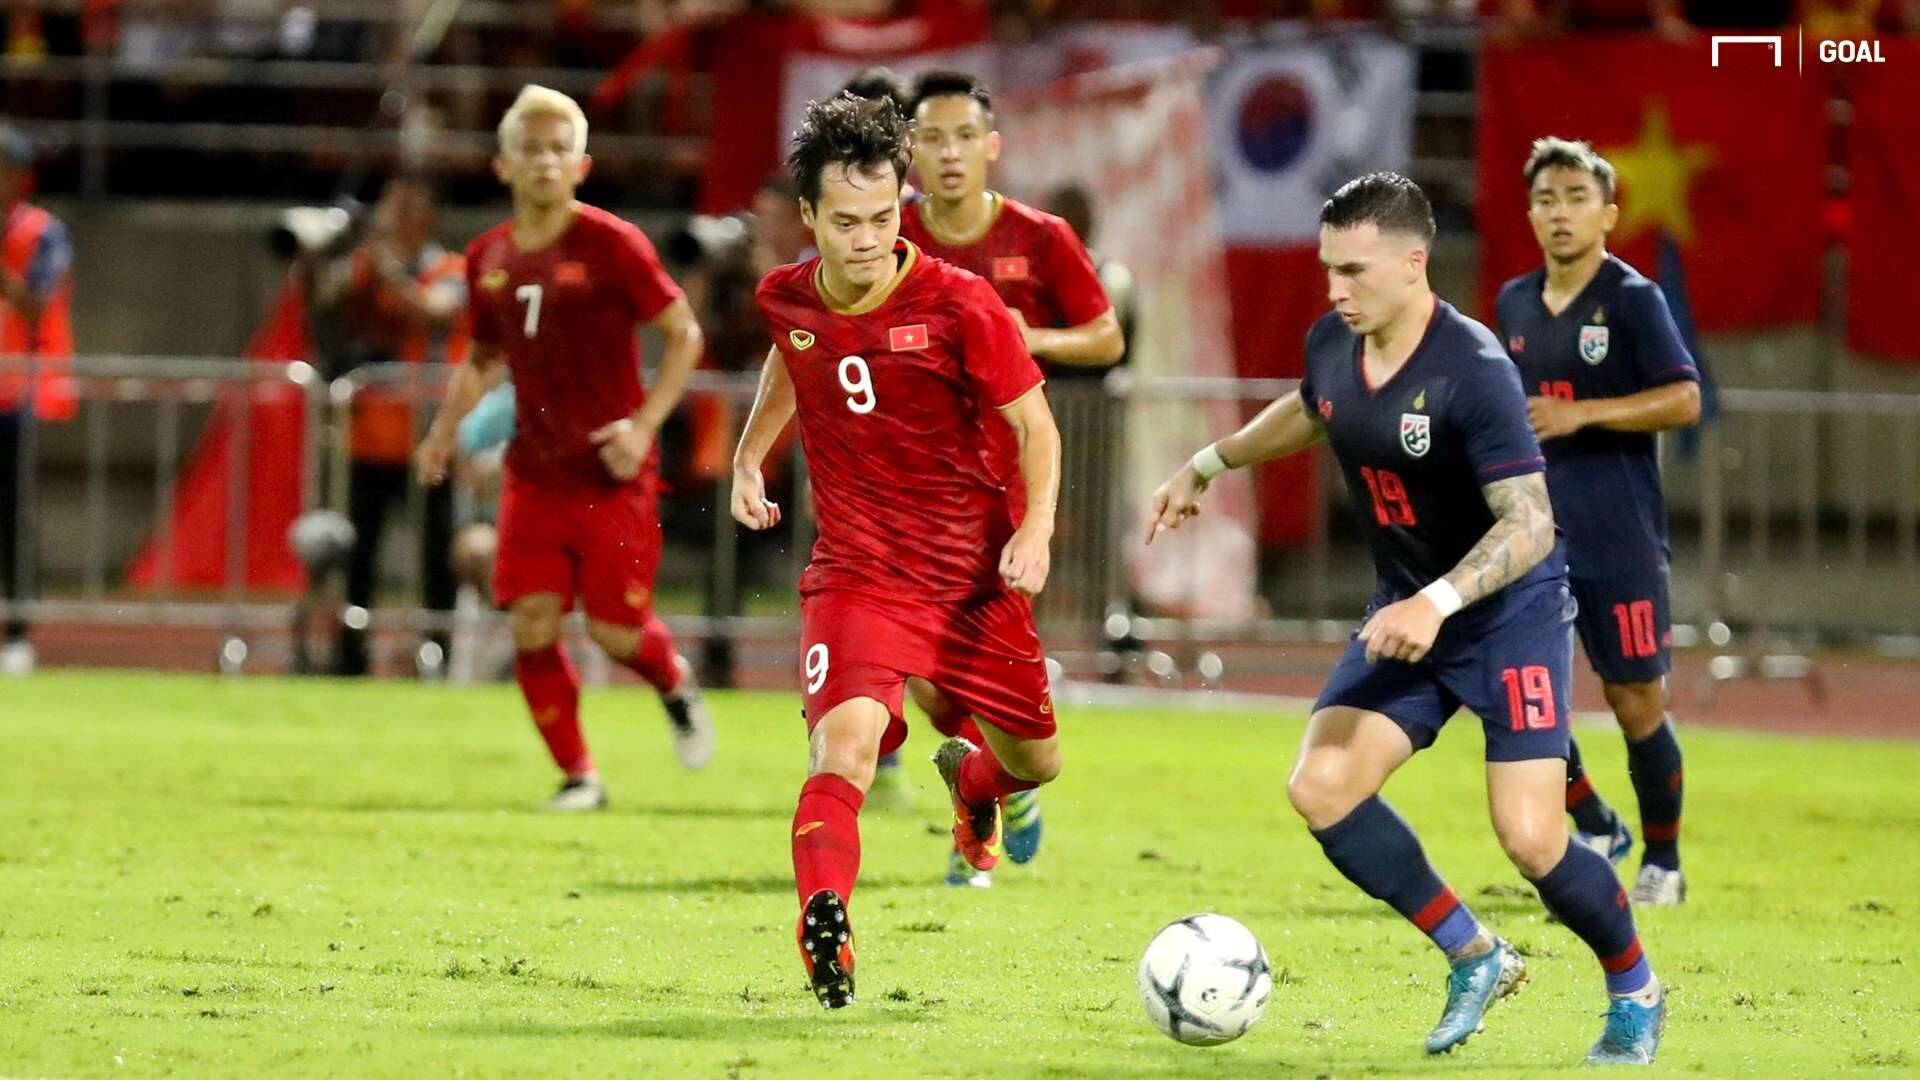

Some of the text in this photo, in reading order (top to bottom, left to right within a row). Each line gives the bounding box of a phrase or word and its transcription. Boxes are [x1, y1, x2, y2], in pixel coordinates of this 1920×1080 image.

[515, 284, 543, 339] 7
[838, 355, 876, 414] 9
[1361, 466, 1417, 525] 19
[1613, 600, 1657, 657] 10
[805, 643, 829, 695] 9
[1502, 665, 1556, 732] 19
